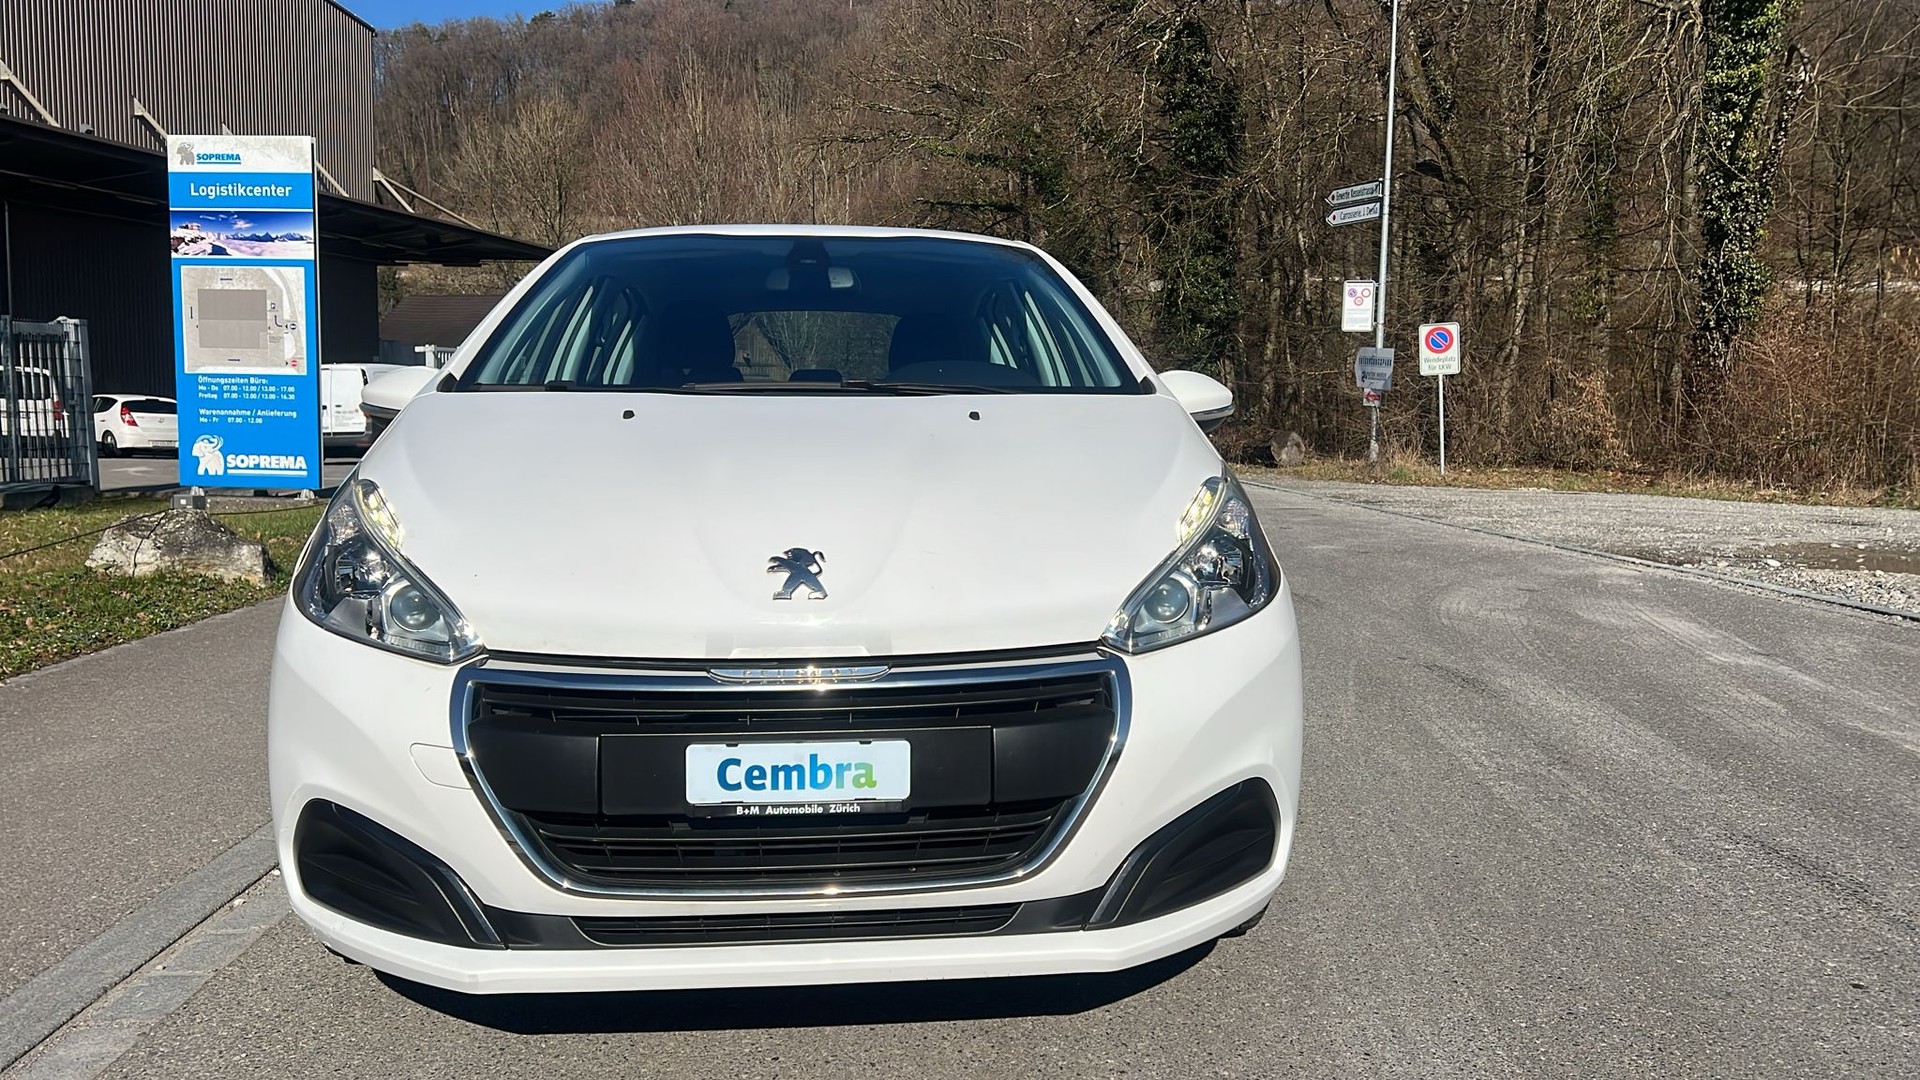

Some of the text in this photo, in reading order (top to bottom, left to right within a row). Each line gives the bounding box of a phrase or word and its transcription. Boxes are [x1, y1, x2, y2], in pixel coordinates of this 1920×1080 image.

[196, 153, 241, 161] SOPREMA
[190, 183, 293, 199] Logistikcenter
[198, 375, 249, 384] Öffnungszeiten
[199, 408, 251, 416] Warenannahme
[256, 409, 297, 419] Anlieferung
[226, 454, 308, 470] SOPREMA
[717, 754, 877, 792] Cembra
[736, 803, 861, 816] B+M Automobile Zürich
